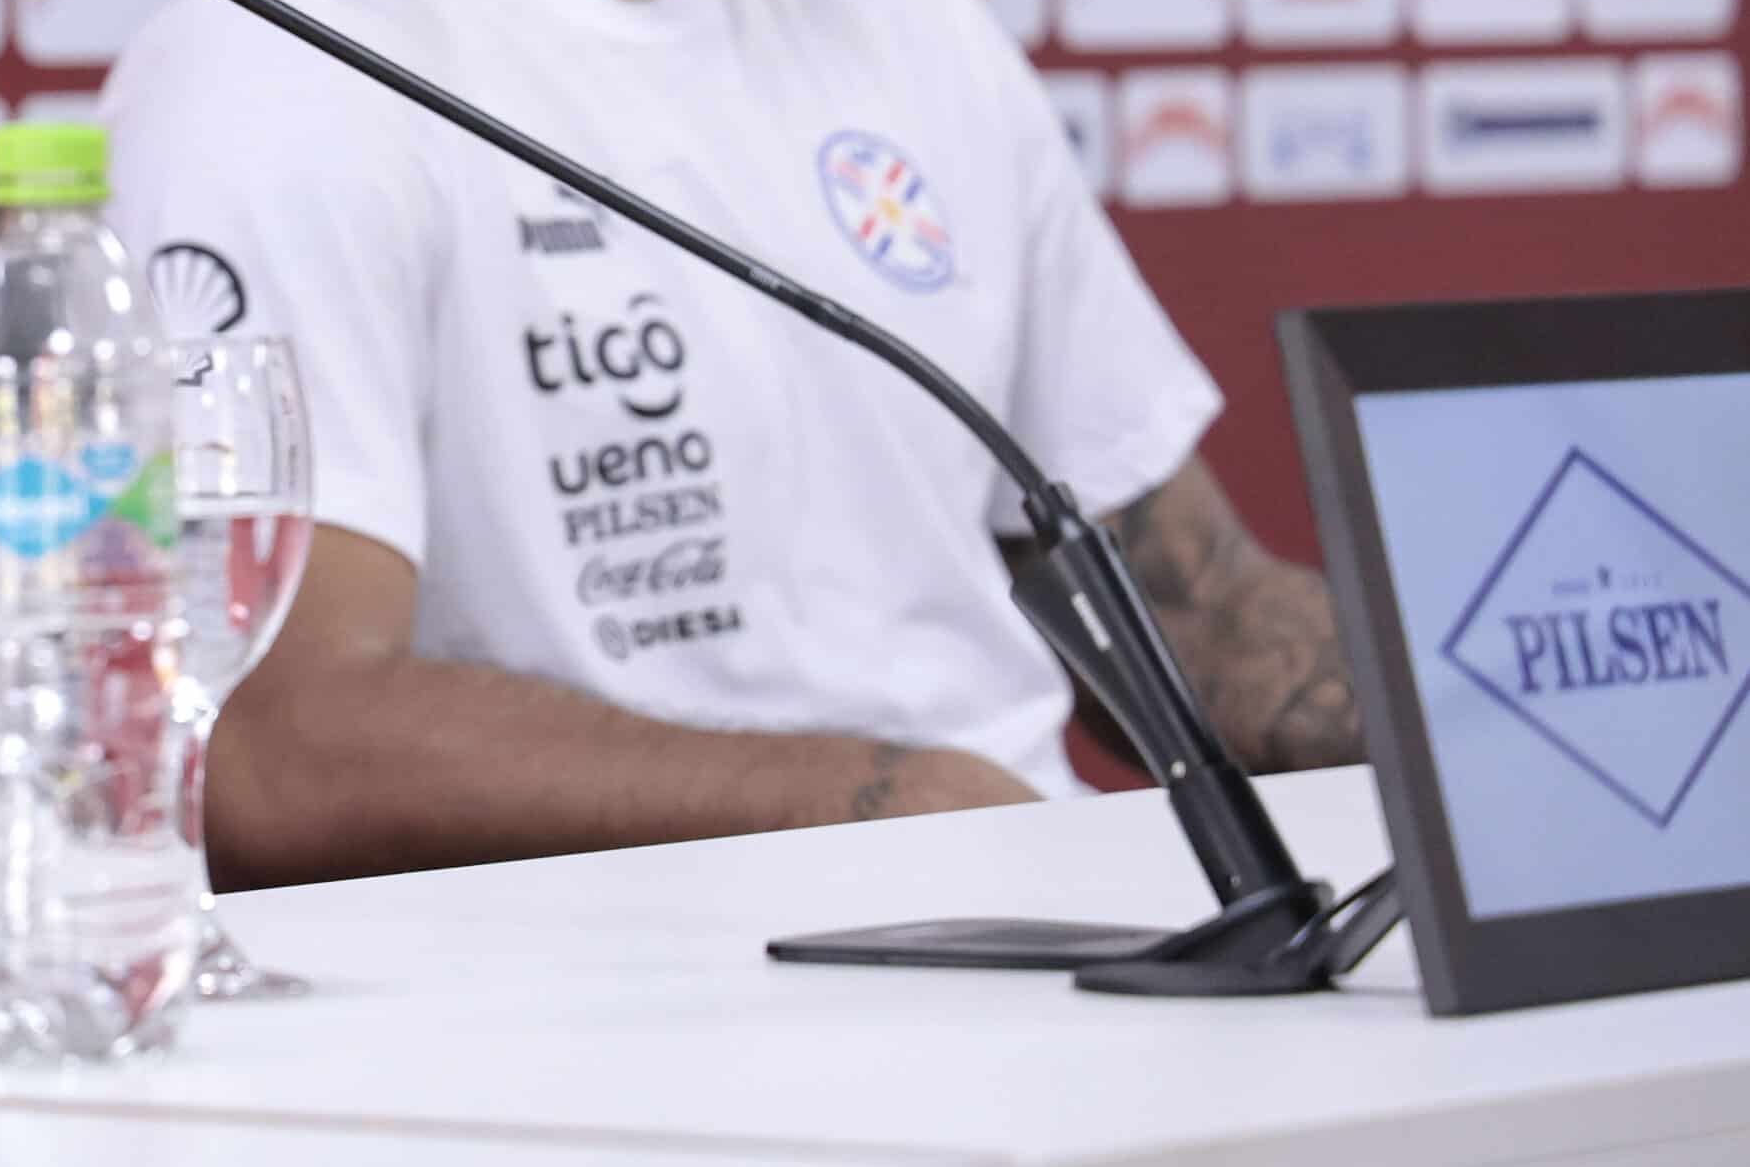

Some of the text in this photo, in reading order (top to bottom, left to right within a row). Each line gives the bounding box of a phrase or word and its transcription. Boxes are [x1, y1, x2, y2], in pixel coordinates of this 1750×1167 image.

[523, 293, 687, 420] tigo
[549, 431, 713, 497] ueno
[565, 490, 722, 544] PILSEN
[1505, 600, 1729, 694] PILSEN
